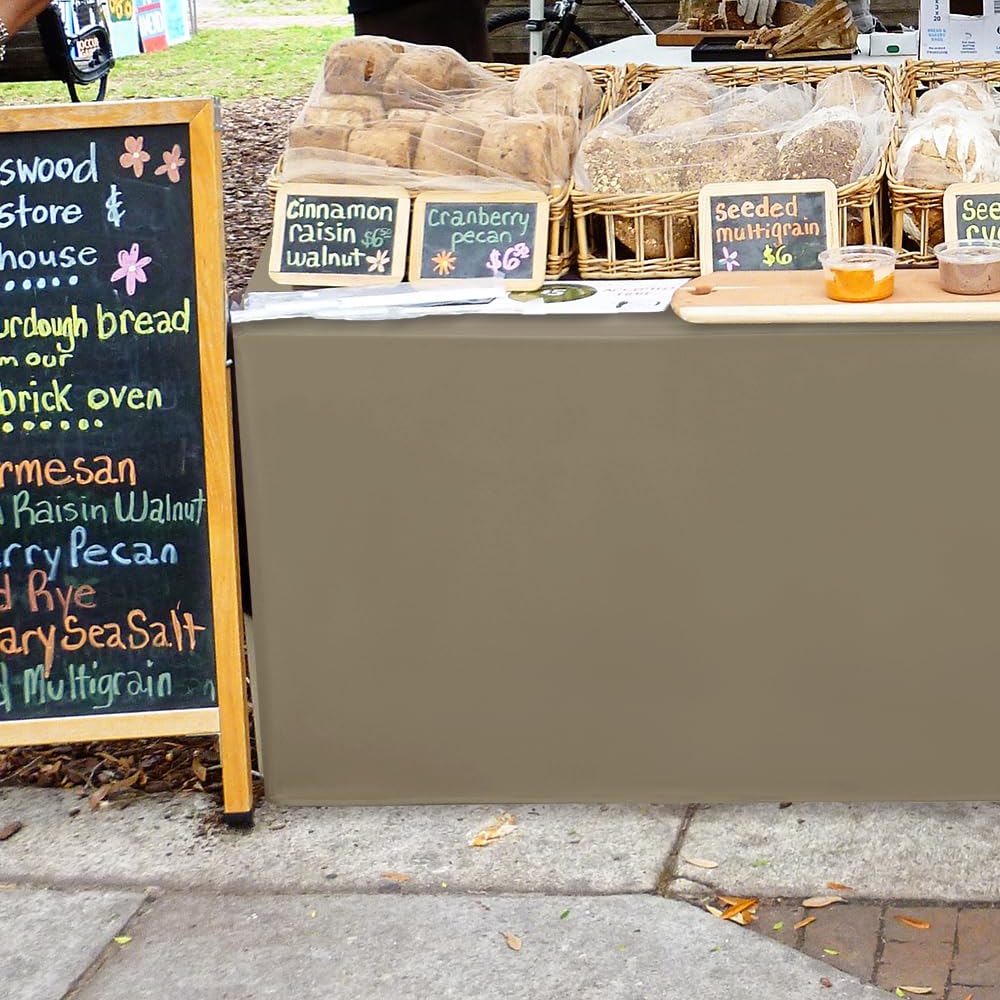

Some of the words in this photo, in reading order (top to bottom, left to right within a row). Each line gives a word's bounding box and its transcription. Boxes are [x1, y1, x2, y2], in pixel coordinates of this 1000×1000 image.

[0, 142, 99, 186] swood
[0, 194, 84, 229] store
[105, 184, 126, 228] &
[288, 222, 357, 244] raisin
[451, 229, 513, 253] pecan
[716, 216, 820, 248] multigrain
[0, 242, 98, 271] house
[285, 244, 367, 268] walnut
[762, 243, 793, 268] $6
[96, 297, 191, 341] bread
[25, 352, 74, 369] our
[0, 378, 74, 417] brick
[87, 385, 163, 410] oven
[13, 490, 107, 529] Raisin
[115, 488, 206, 526] Walnut
[70, 526, 179, 568] Pecan
[28, 569, 97, 618] Rye
[23, 660, 173, 710] Multigrain
